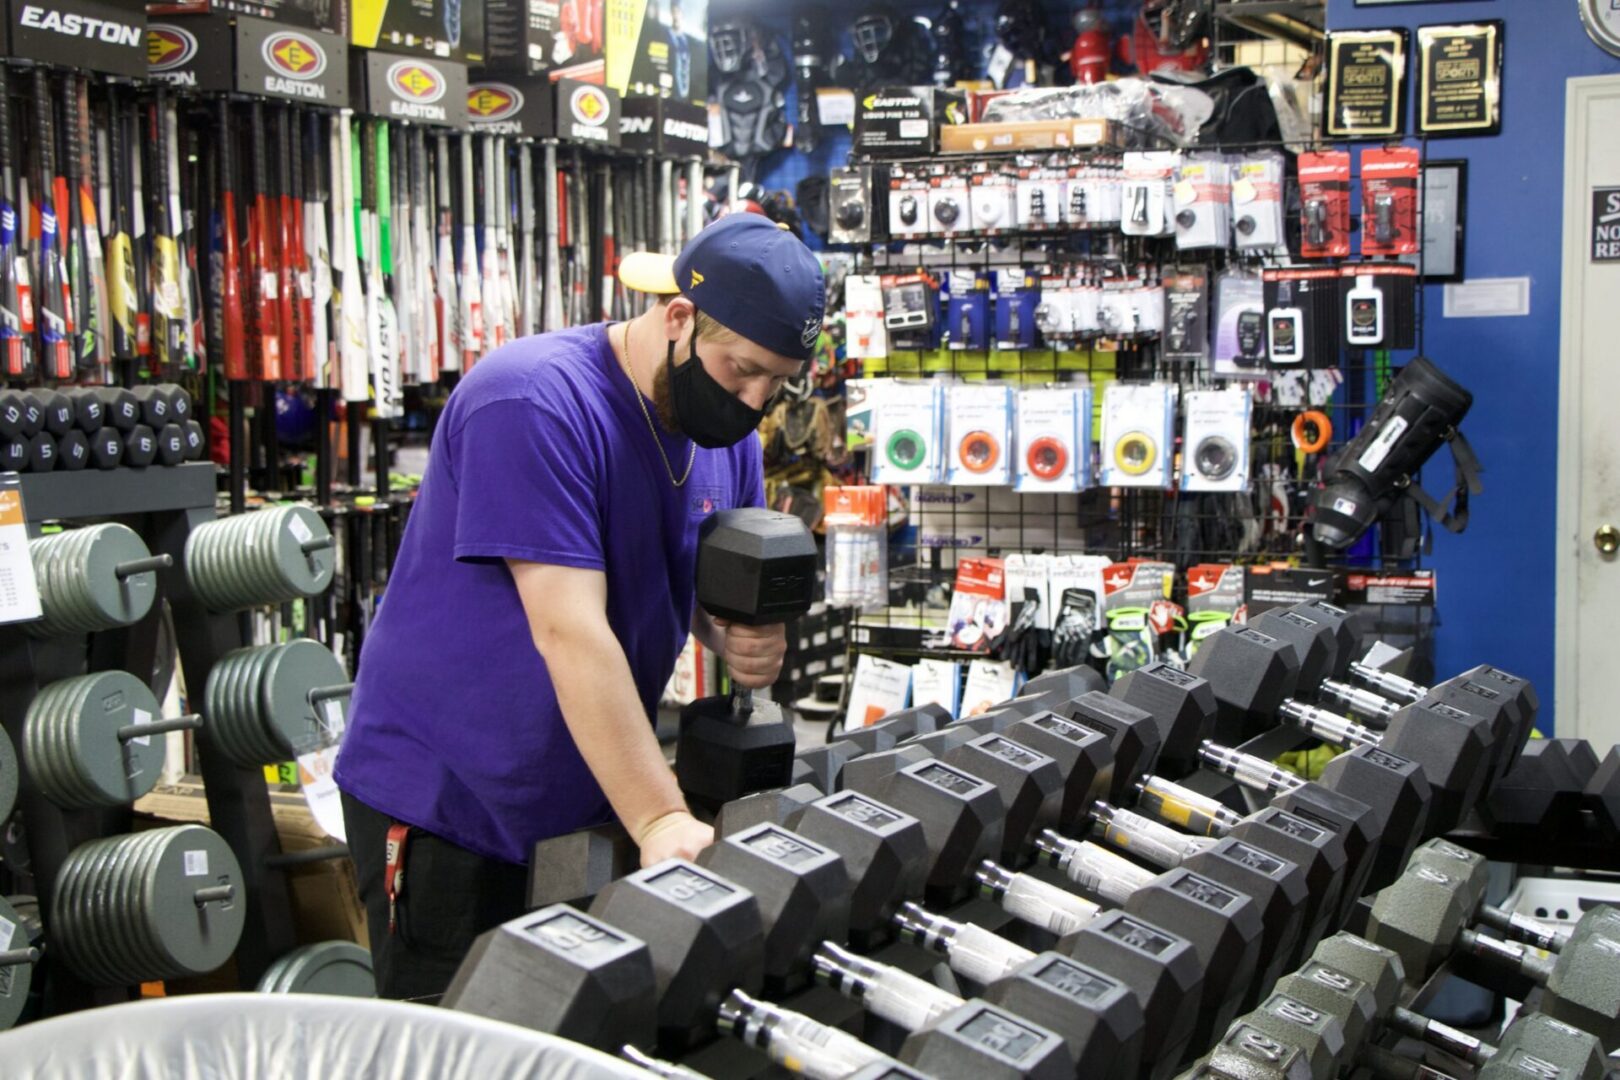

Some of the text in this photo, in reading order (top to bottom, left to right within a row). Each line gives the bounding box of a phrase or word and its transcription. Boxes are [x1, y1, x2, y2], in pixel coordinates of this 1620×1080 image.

[20, 6, 142, 46] EASTON
[265, 76, 326, 98] EASTON
[390, 100, 446, 120] EASTON
[873, 97, 921, 108] EASTON
[571, 122, 608, 141] EASTON
[663, 117, 708, 142] EASTON
[88, 403, 100, 419] 5
[123, 402, 134, 417] 6
[155, 400, 166, 416] 6
[41, 444, 52, 458] 5
[107, 441, 118, 455] 6
[141, 437, 152, 452] 6
[170, 437, 180, 451] 6
[668, 875, 714, 901] 30
[551, 922, 605, 951] 30
